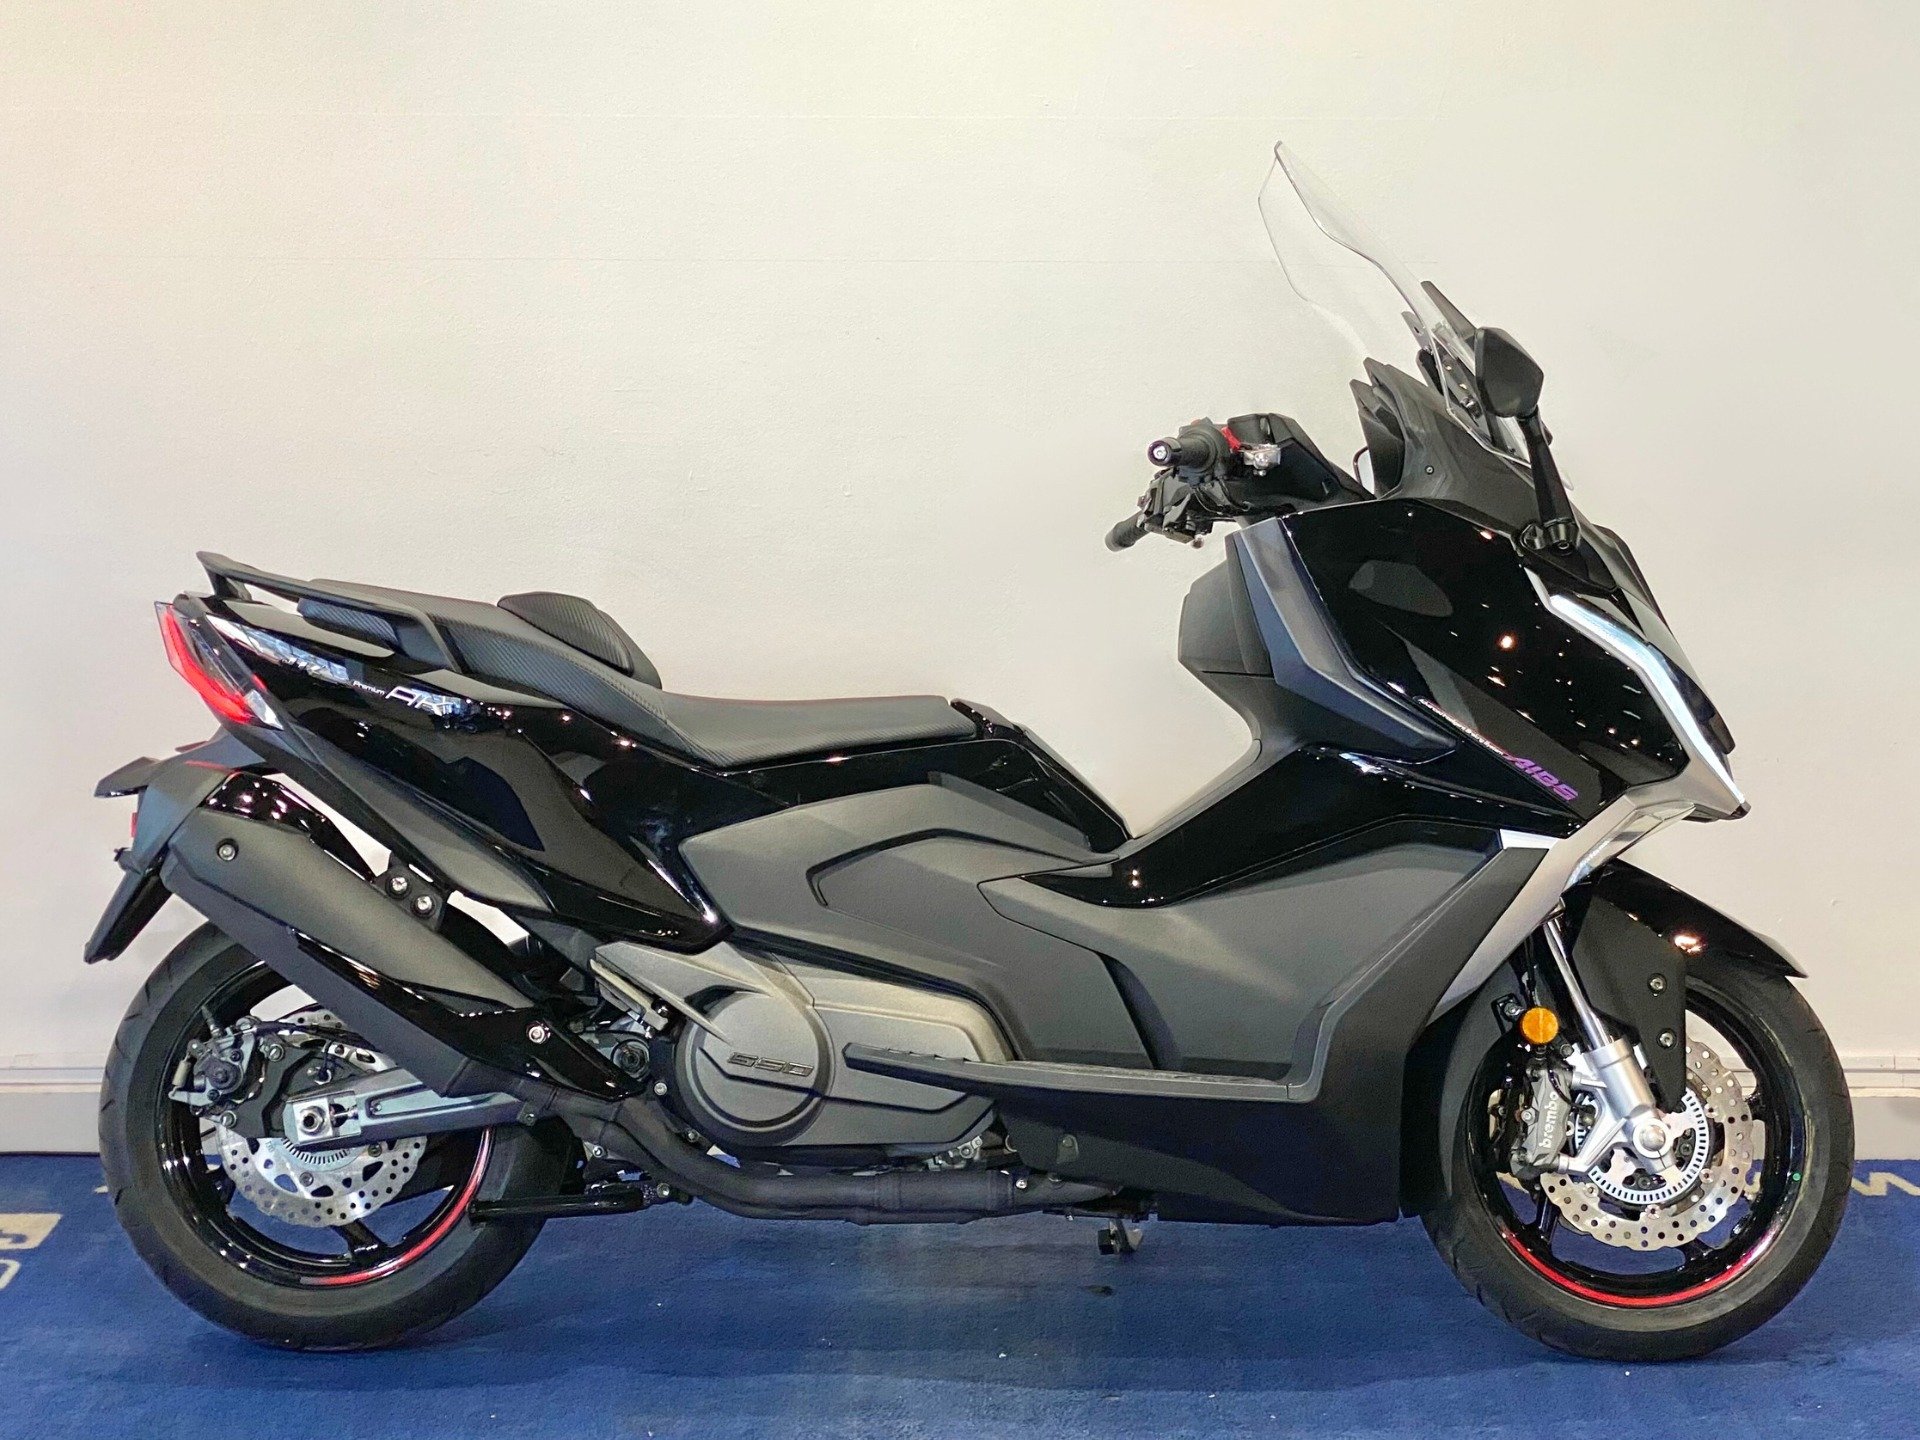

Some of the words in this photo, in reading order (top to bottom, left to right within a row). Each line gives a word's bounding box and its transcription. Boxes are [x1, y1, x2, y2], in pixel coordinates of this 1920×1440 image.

[353, 680, 385, 696] Premium
[727, 1052, 815, 1077] 550
[1539, 1091, 1558, 1149] brembo
